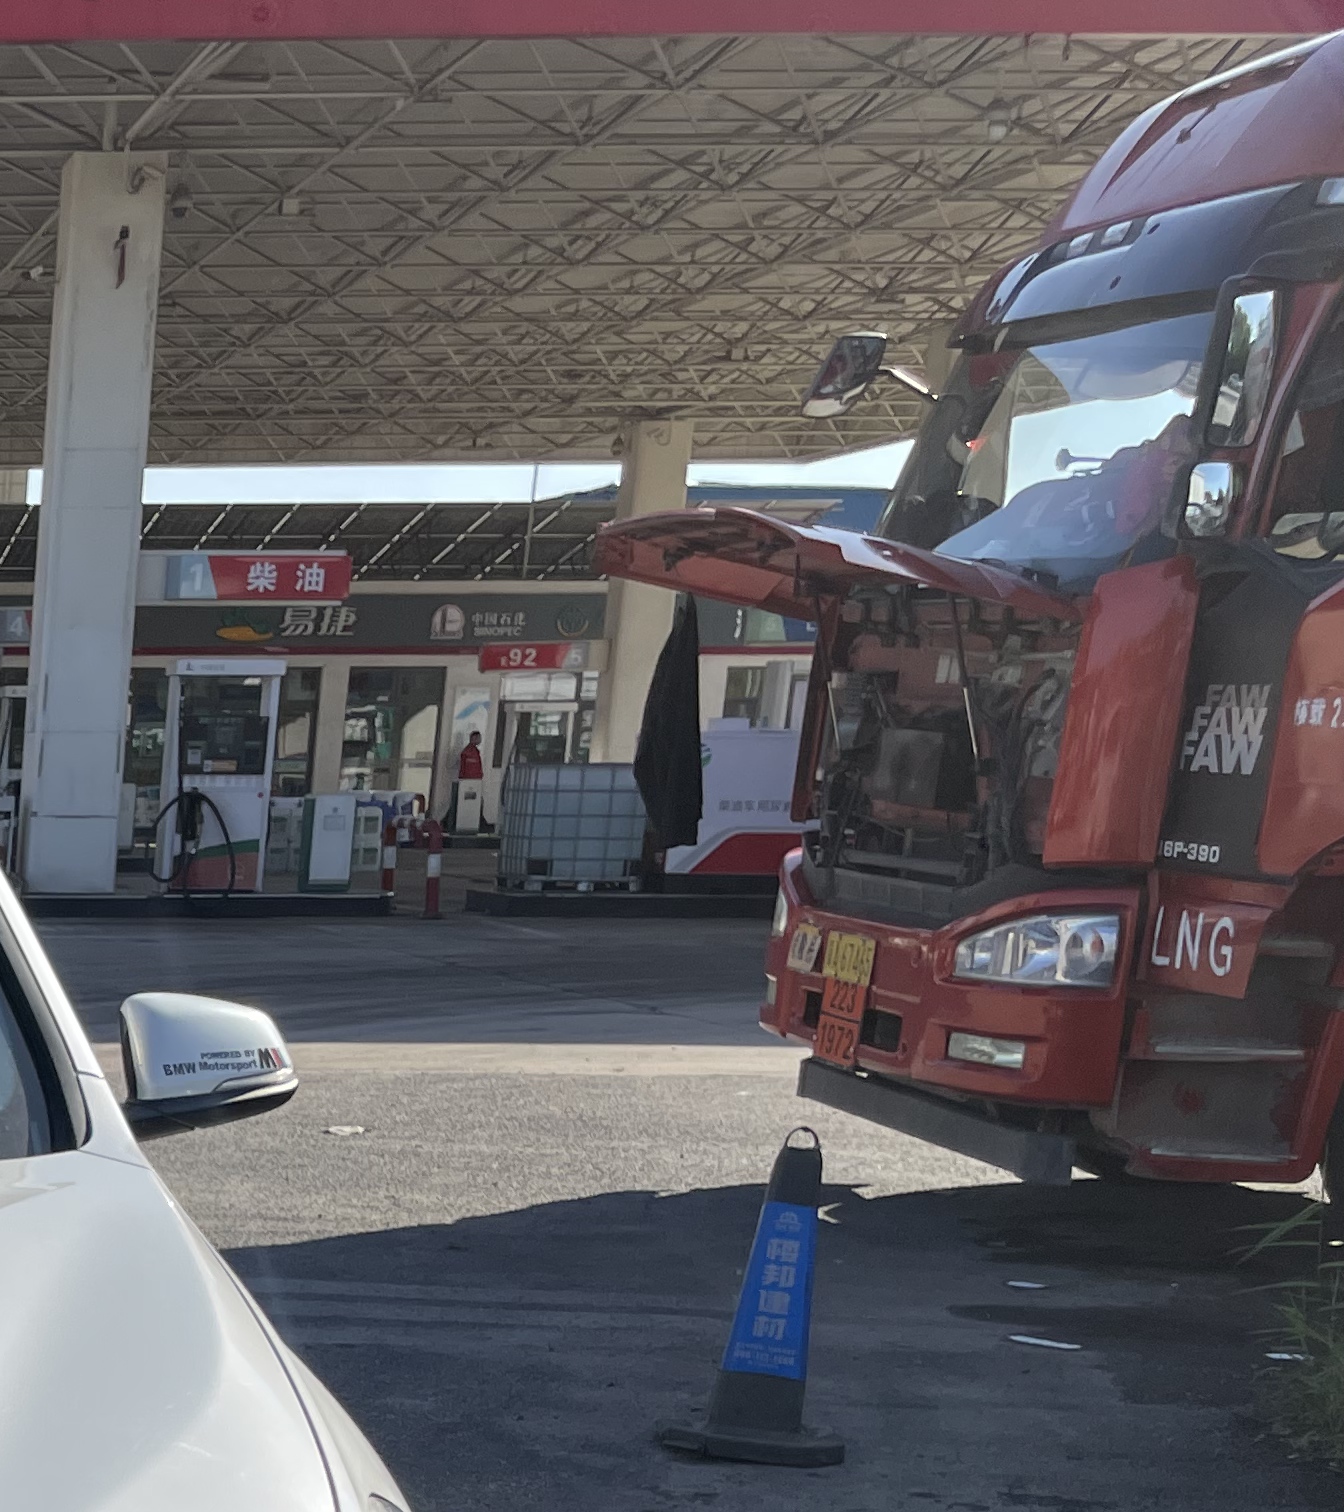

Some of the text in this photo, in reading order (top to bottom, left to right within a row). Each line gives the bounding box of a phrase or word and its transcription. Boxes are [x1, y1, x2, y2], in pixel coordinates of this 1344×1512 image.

[189, 562, 326, 594] 1 柴油
[8, 618, 25, 638] 4
[279, 606, 358, 637] 易捷
[471, 611, 526, 626] 中国石化
[473, 626, 523, 637] SINOPEC
[1179, 730, 1264, 775] FAW
[1160, 839, 1221, 864] 6P-390
[1151, 905, 1235, 977] LNG
[829, 979, 859, 1014] 223
[200, 1049, 256, 1060] POWERED BY
[817, 1021, 855, 1060] 1972
[162, 1058, 258, 1077] BMW Motorsport
